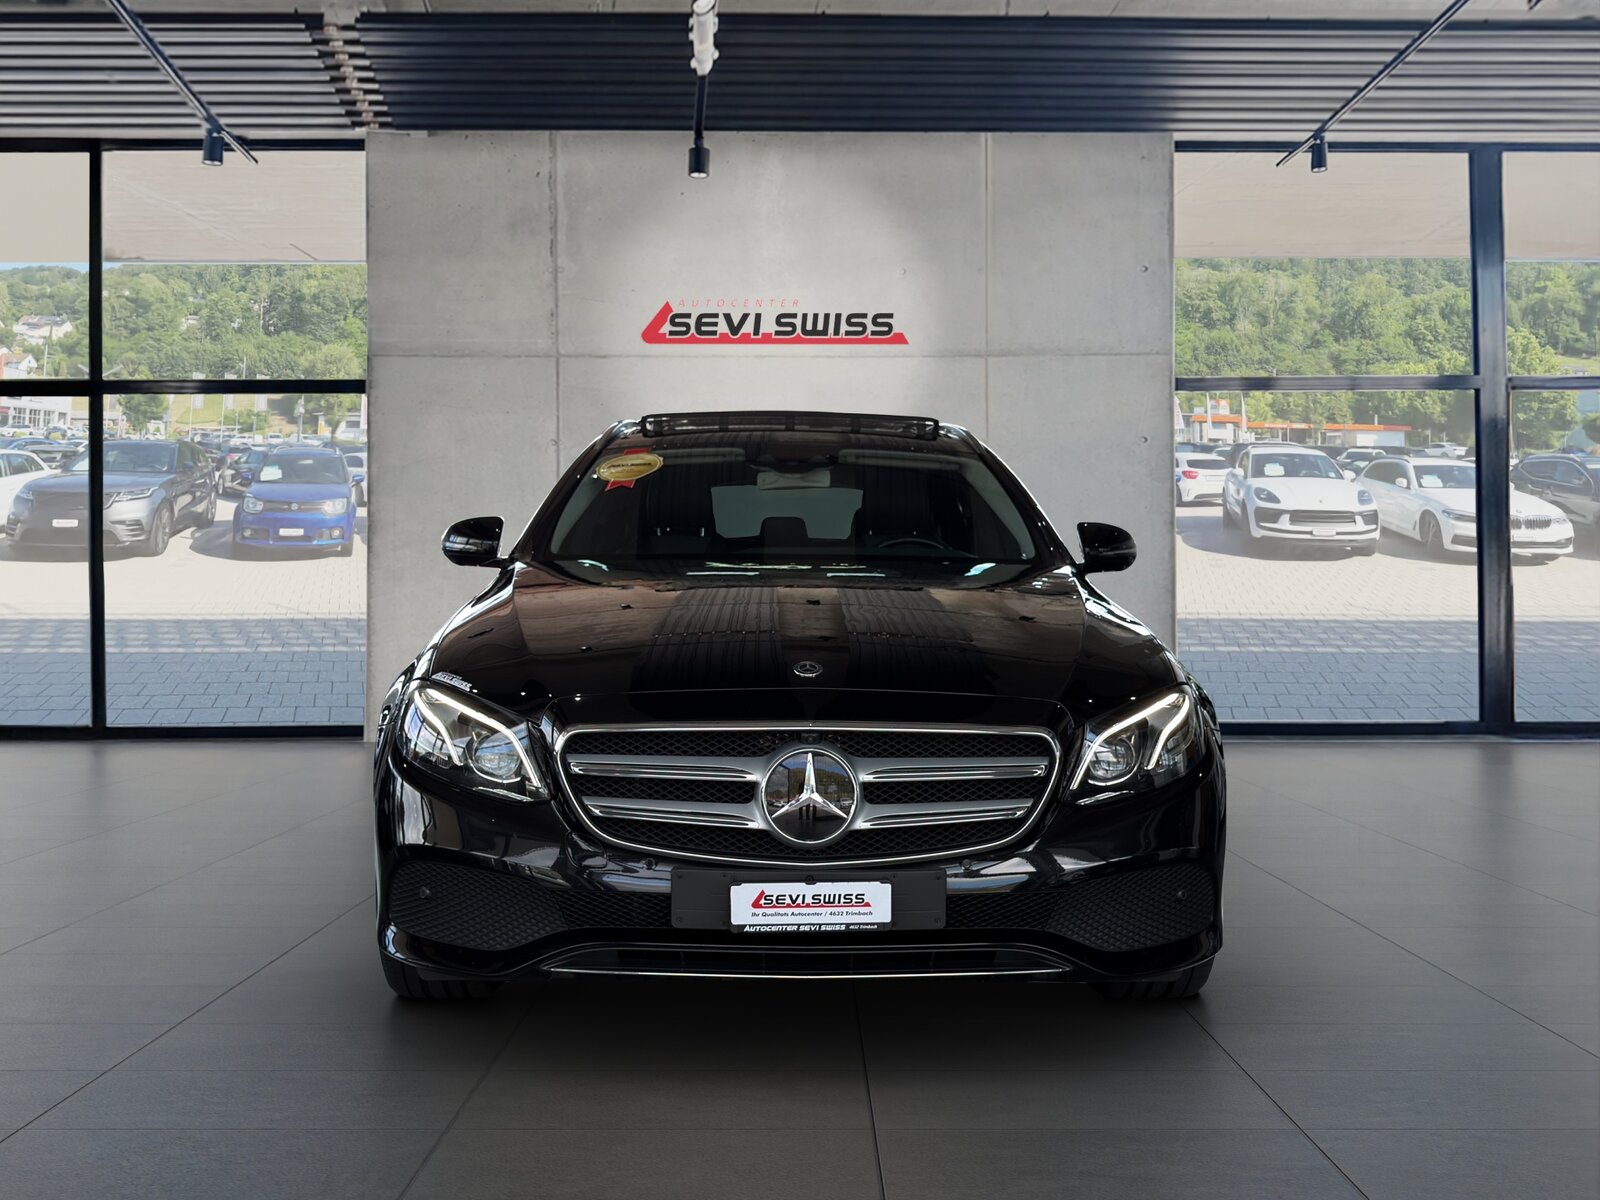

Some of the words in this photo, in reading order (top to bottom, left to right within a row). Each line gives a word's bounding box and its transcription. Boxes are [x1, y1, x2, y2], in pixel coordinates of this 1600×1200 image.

[677, 298, 800, 308] AUTOCENTER
[668, 312, 763, 337] SEVI
[774, 312, 895, 337] SWISS
[762, 894, 806, 906] SEVI
[811, 893, 866, 905] SWISS
